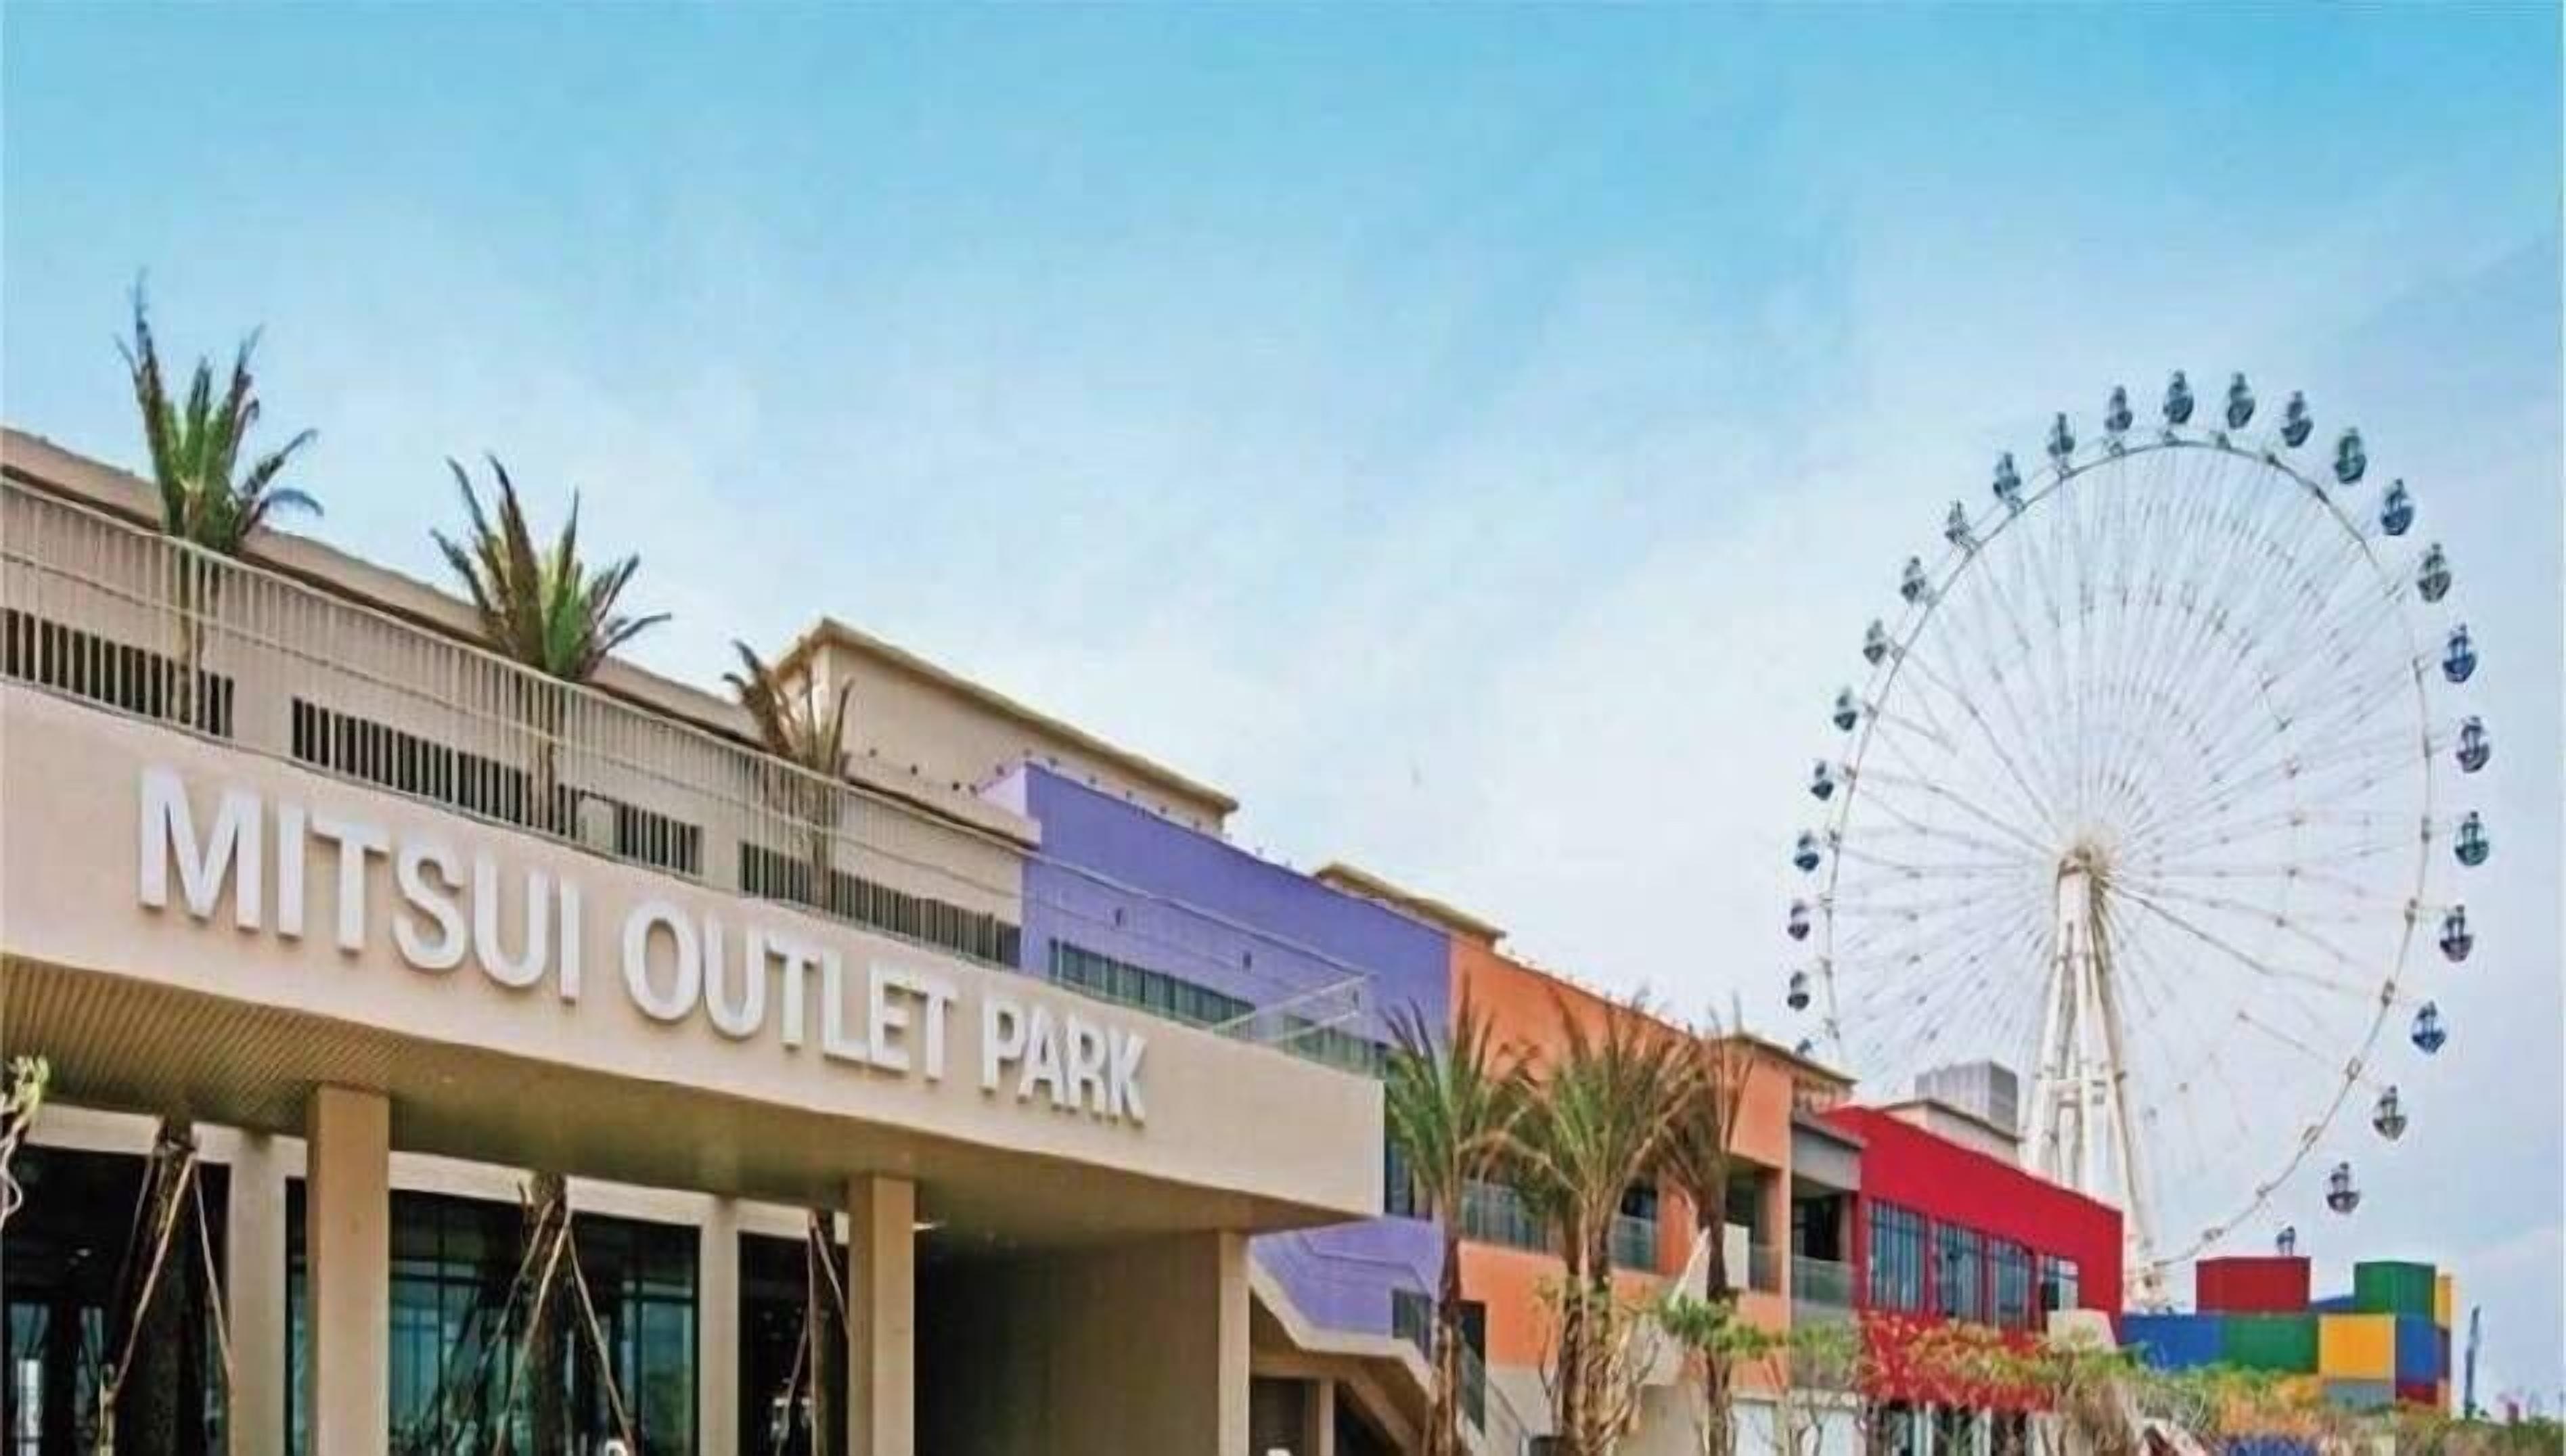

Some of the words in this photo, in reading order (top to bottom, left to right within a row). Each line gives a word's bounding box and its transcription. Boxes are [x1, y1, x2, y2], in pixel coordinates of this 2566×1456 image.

[138, 765, 581, 1004] MITSUI
[621, 899, 959, 1083] OUTLET
[980, 995, 1148, 1128] PARK
